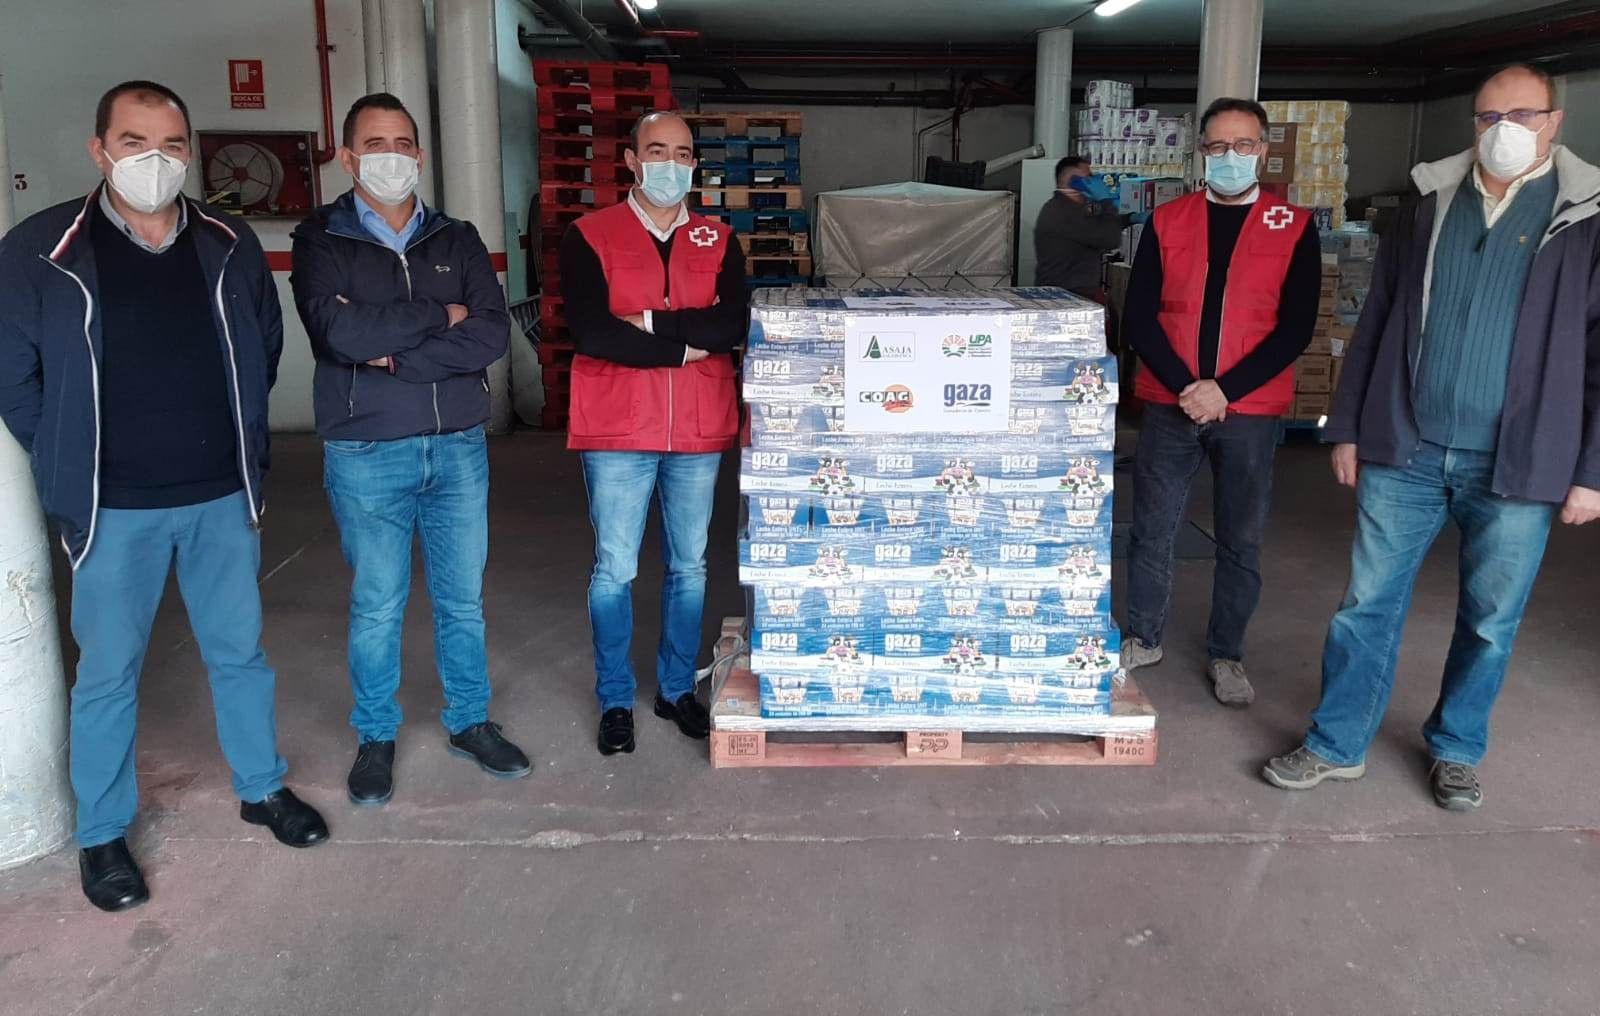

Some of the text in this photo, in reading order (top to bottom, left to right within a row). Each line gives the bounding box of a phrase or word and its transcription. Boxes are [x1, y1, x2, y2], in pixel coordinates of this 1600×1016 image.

[14, 173, 28, 190] 3
[882, 344, 912, 354] ASAJA
[968, 334, 992, 346] UPA
[753, 359, 791, 379] gaza
[859, 391, 911, 403] COAG
[943, 383, 992, 407] gaza
[751, 452, 789, 471] gaza
[877, 453, 913, 473] gaza
[1001, 454, 1039, 473] gaza
[750, 543, 787, 562] gaza
[875, 543, 912, 562] gaza
[1000, 543, 1037, 562] gaza
[761, 632, 798, 651] gaza
[884, 633, 921, 651] gaza
[1010, 633, 1047, 653] gaza
[1113, 746, 1145, 756] 1940C
